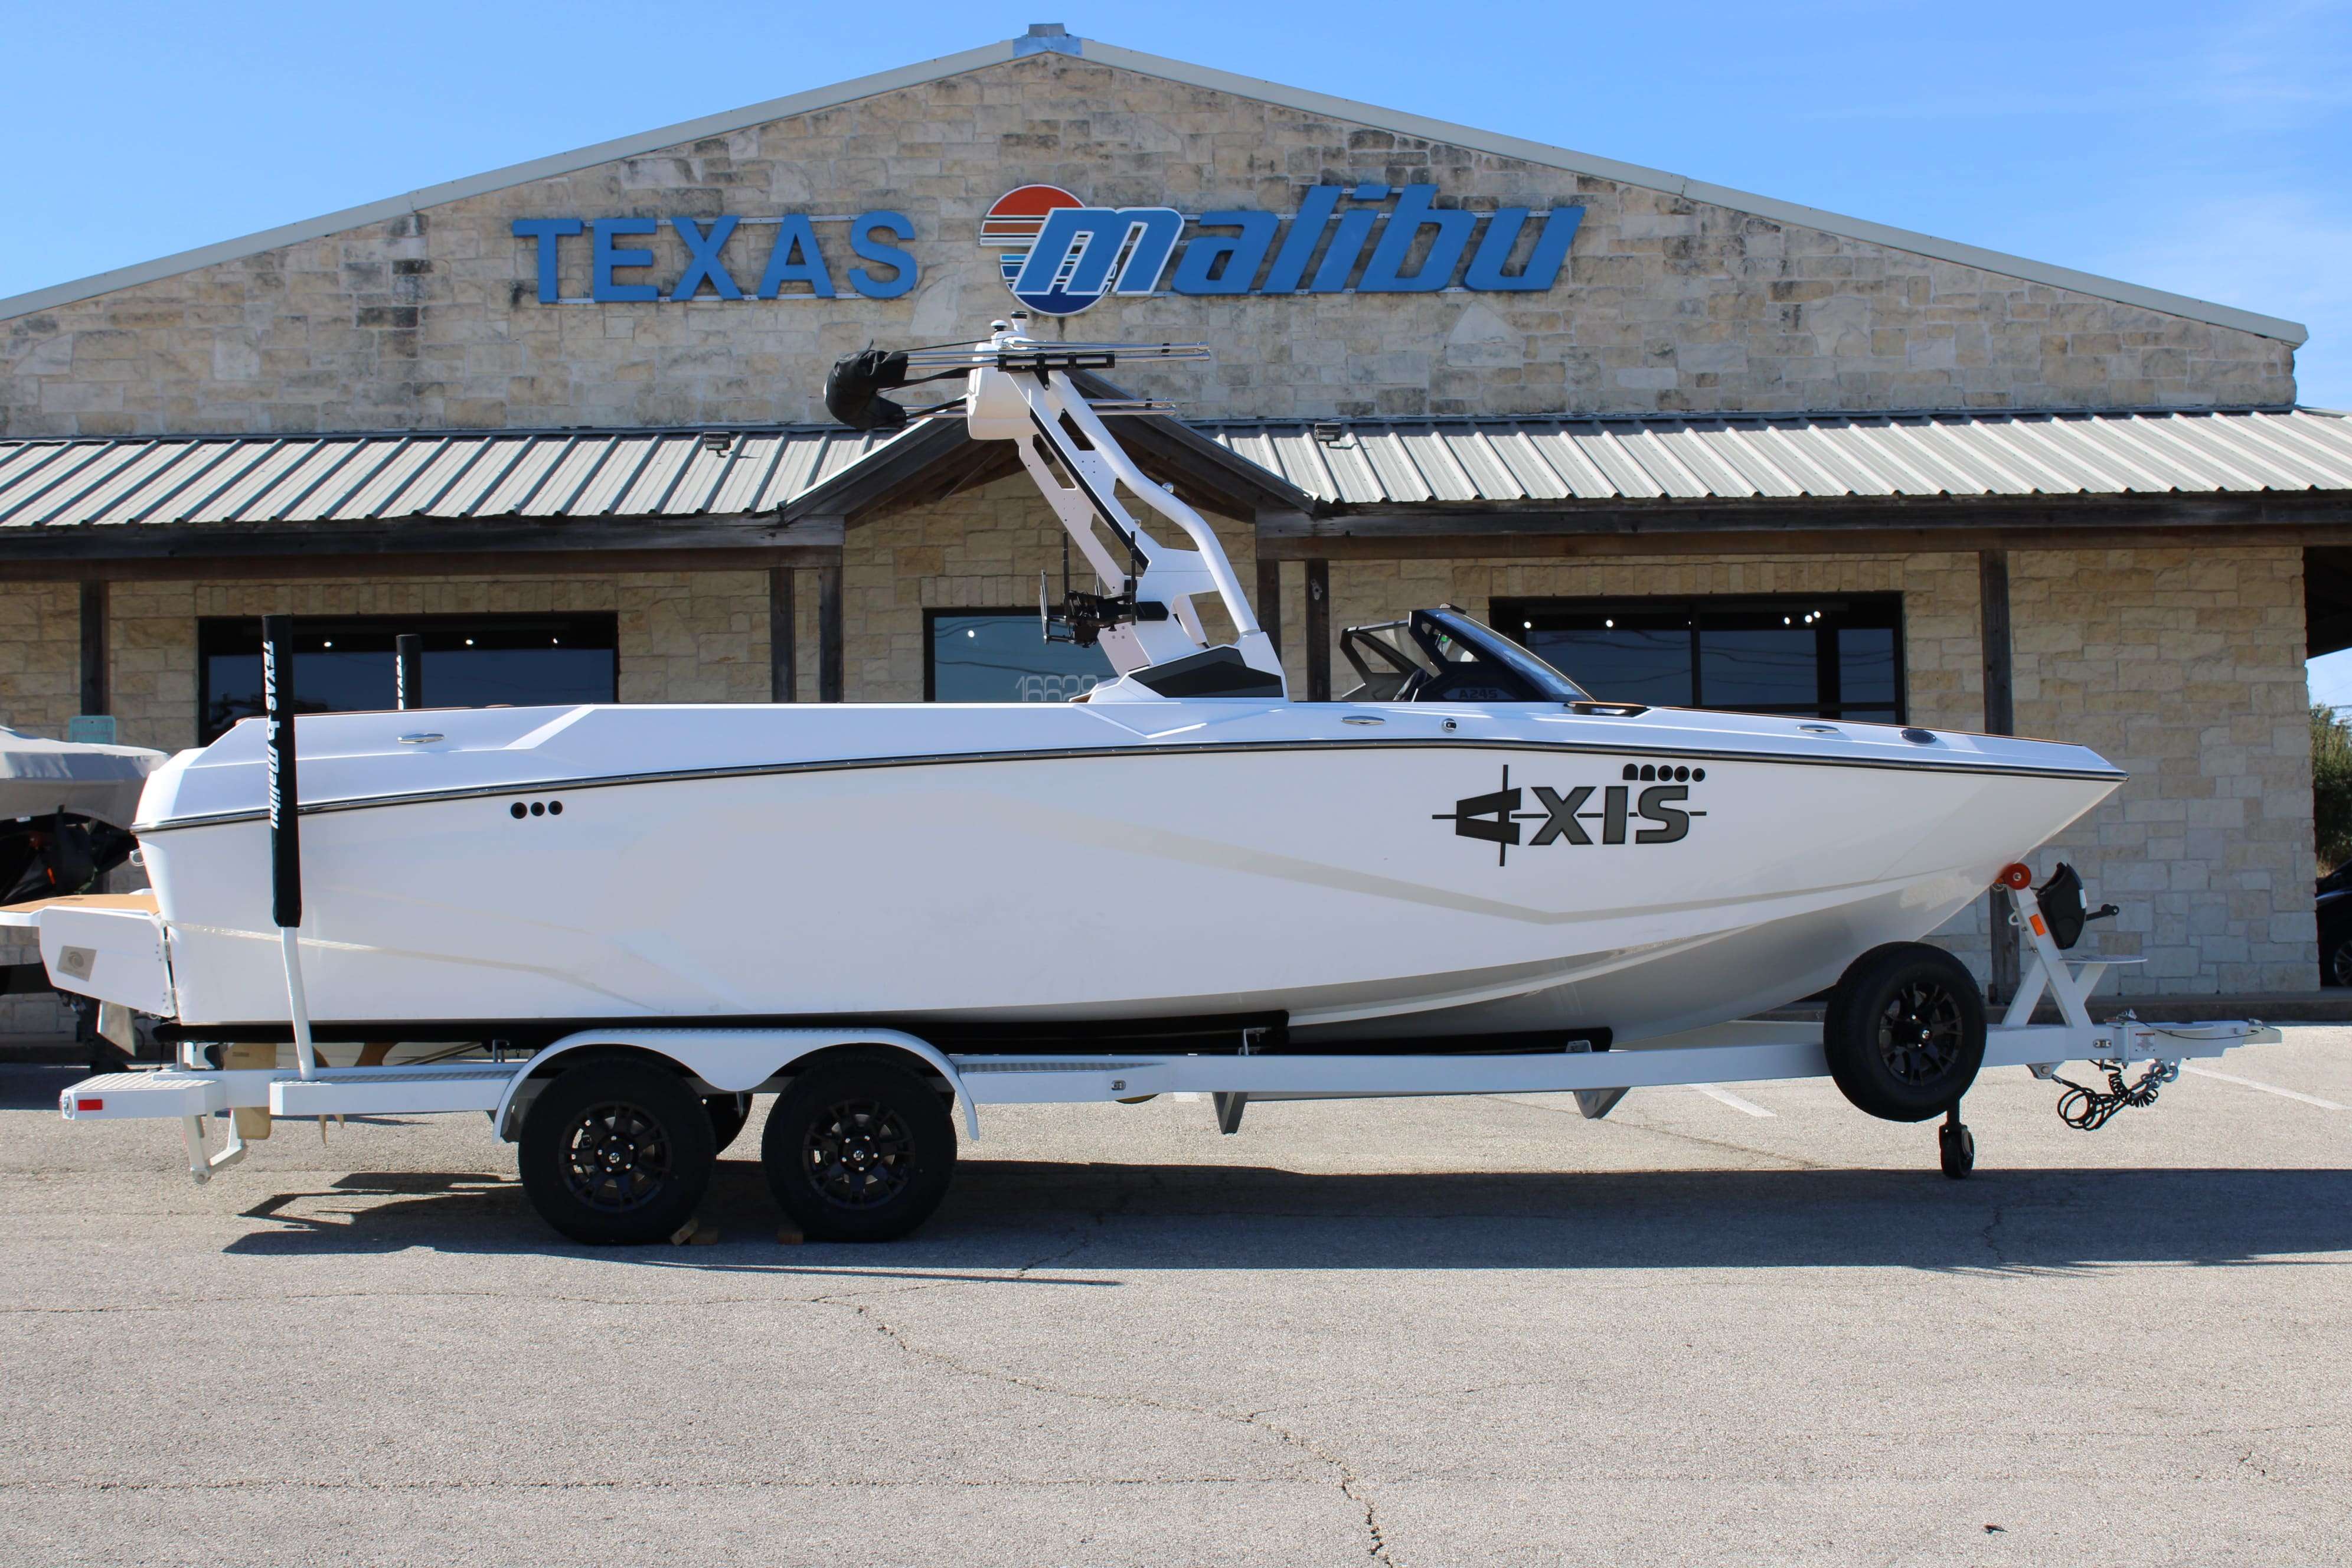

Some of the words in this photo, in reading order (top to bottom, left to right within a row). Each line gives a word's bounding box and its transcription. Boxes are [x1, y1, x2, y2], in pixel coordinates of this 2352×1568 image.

[512, 210, 918, 304] TEXAS
[264, 641, 277, 711] TEXAS
[1459, 689, 1498, 700] A245
[1456, 765, 1690, 867] AXIS
